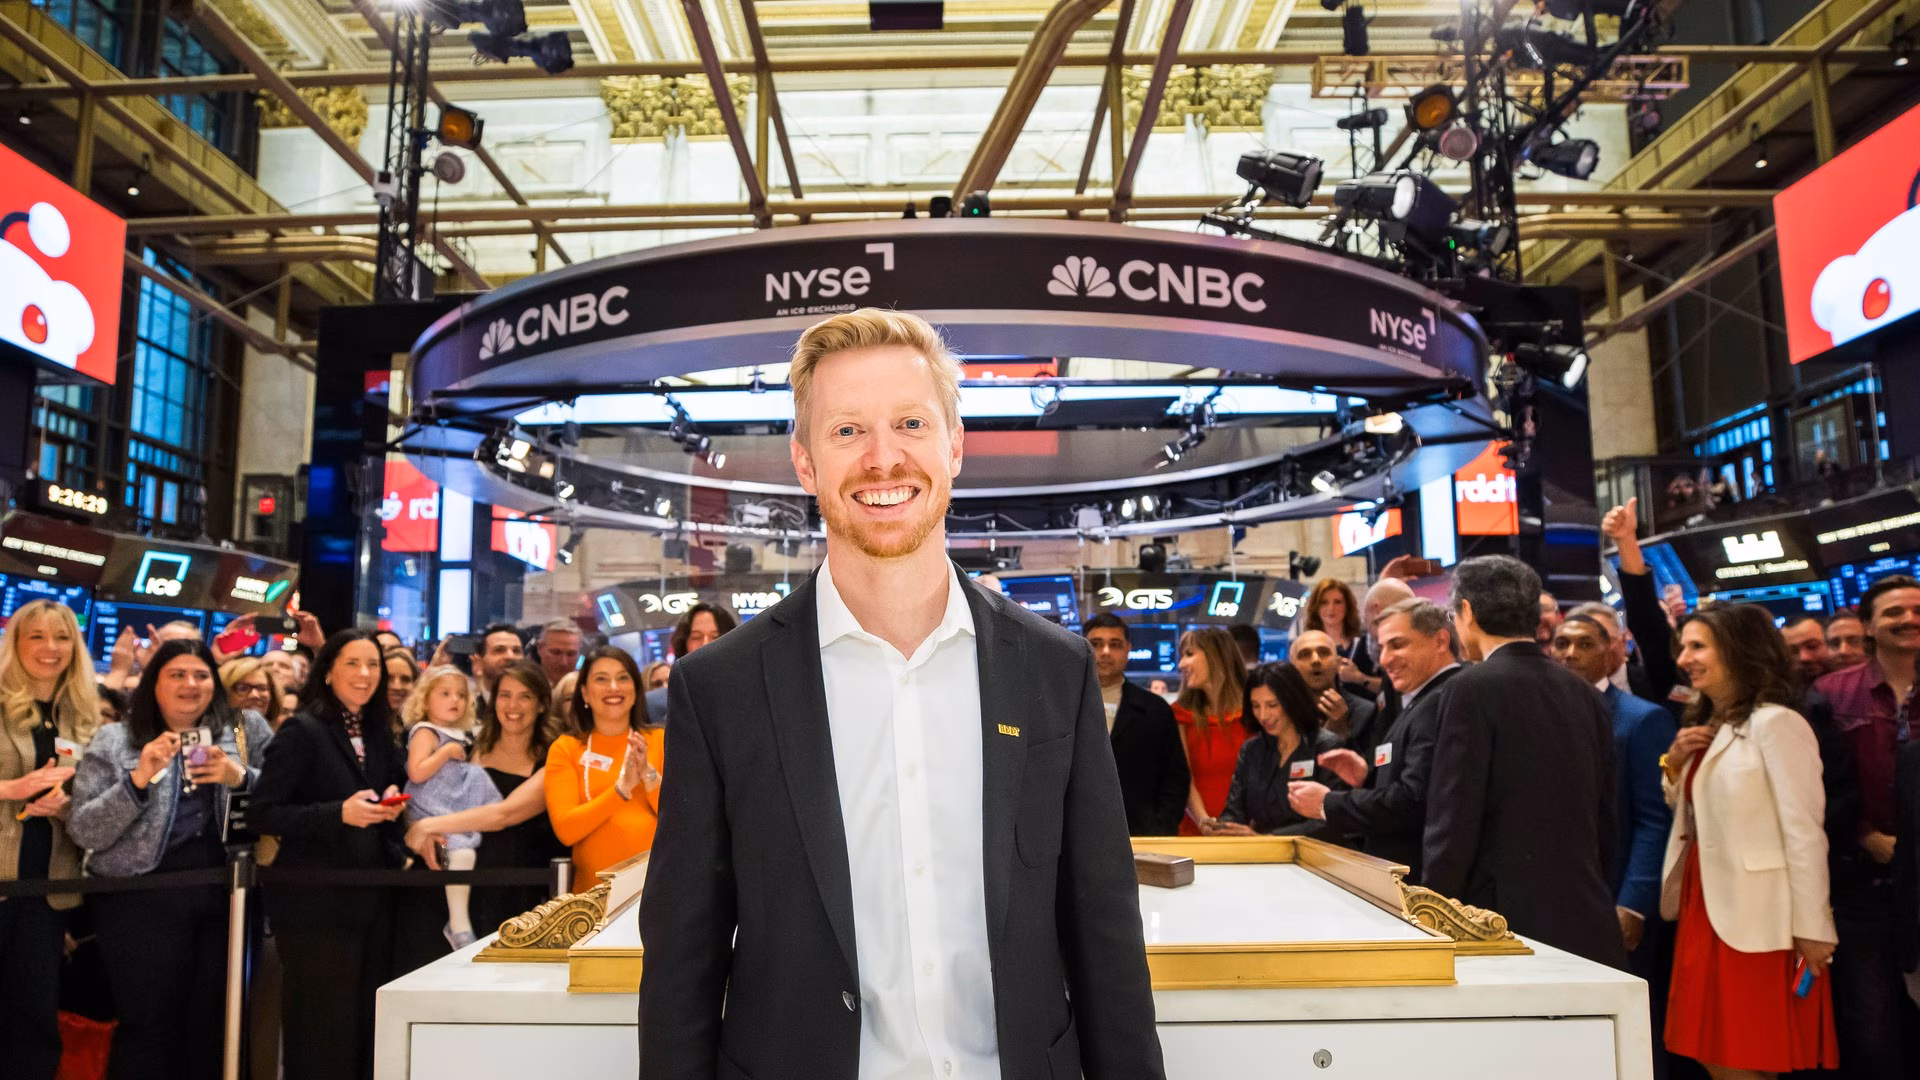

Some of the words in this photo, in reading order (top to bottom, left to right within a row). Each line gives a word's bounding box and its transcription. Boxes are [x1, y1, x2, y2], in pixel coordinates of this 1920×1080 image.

[1118, 259, 1267, 313] CNBC
[516, 285, 630, 346] CNBC
[1125, 588, 1174, 610] GTS
